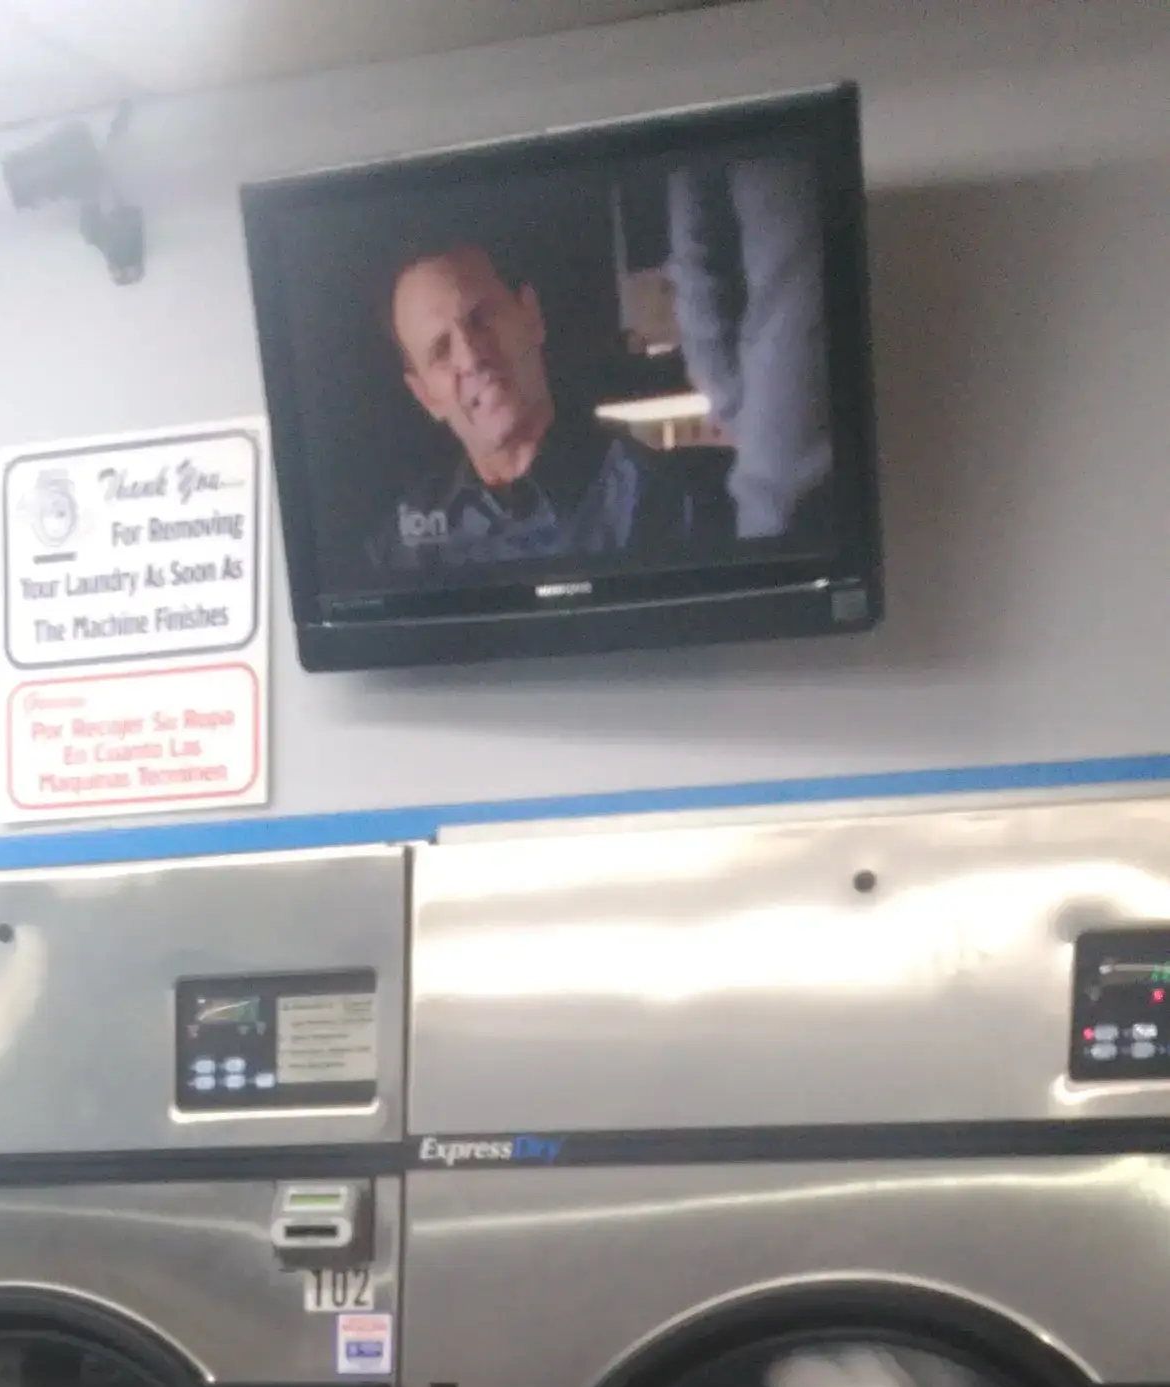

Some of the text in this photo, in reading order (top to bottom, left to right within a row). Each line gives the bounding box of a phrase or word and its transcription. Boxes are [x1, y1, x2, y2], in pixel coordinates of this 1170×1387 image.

[111, 510, 245, 547] For Removing
[20, 554, 243, 600] Your Laundry As Soon As
[33, 603, 229, 643] The Machine Finishes
[310, 1268, 371, 1308] 102
